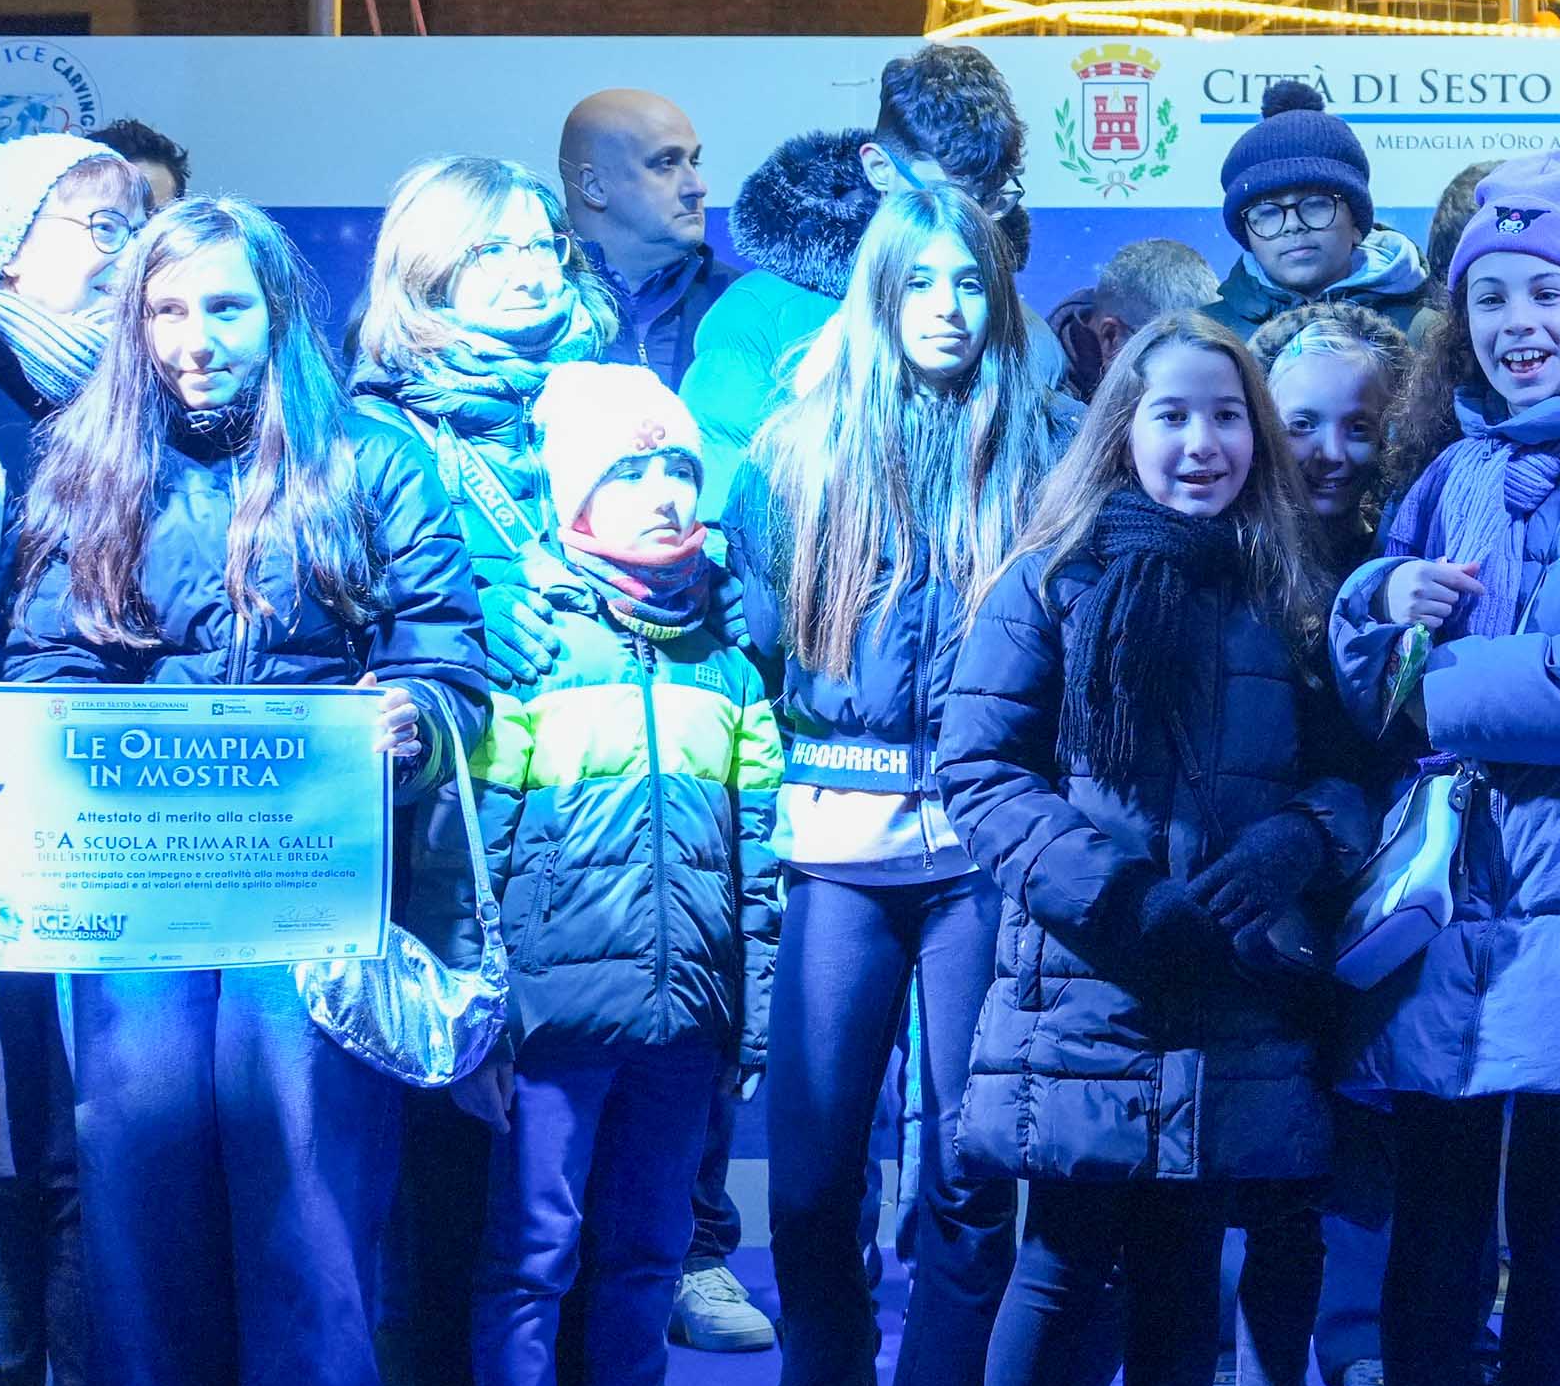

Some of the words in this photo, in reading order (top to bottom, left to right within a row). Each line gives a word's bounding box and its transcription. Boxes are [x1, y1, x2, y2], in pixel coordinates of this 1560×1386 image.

[4, 45, 47, 64] ICE
[52, 56, 96, 127] CARVING
[1352, 73, 1398, 104] DI
[1419, 68, 1552, 104] SESTO
[1375, 133, 1475, 150] MEDAGLIA
[65, 728, 107, 760] LE
[119, 728, 306, 760] OLIMPIADI
[793, 742, 907, 774] HOODRICH
[90, 764, 122, 787] IN
[136, 764, 280, 787] MOSTRA
[77, 811, 142, 824] Attestato
[147, 811, 160, 823] di
[165, 811, 212, 823] merito
[216, 811, 243, 823] alla
[248, 811, 294, 823] classe
[83, 836, 157, 850] SCUOLA
[166, 836, 271, 850] PRIMARIA
[279, 835, 335, 849] GALLI
[130, 852, 225, 862] COMPRENSIVO
[229, 852, 283, 862] STATALE
[287, 852, 329, 862] BREDA
[65, 870, 124, 880] partecipato
[126, 871, 146, 879] con
[148, 869, 192, 880] impegno
[205, 868, 252, 879] creatività
[275, 869, 309, 878] mostra
[311, 868, 356, 878] dedicata
[81, 881, 129, 891] Olimpiadi
[154, 880, 182, 889] valori
[184, 880, 213, 889] eterni
[274, 879, 318, 890] olimpico
[40, 930, 122, 941] CHAMPIONSHIP
